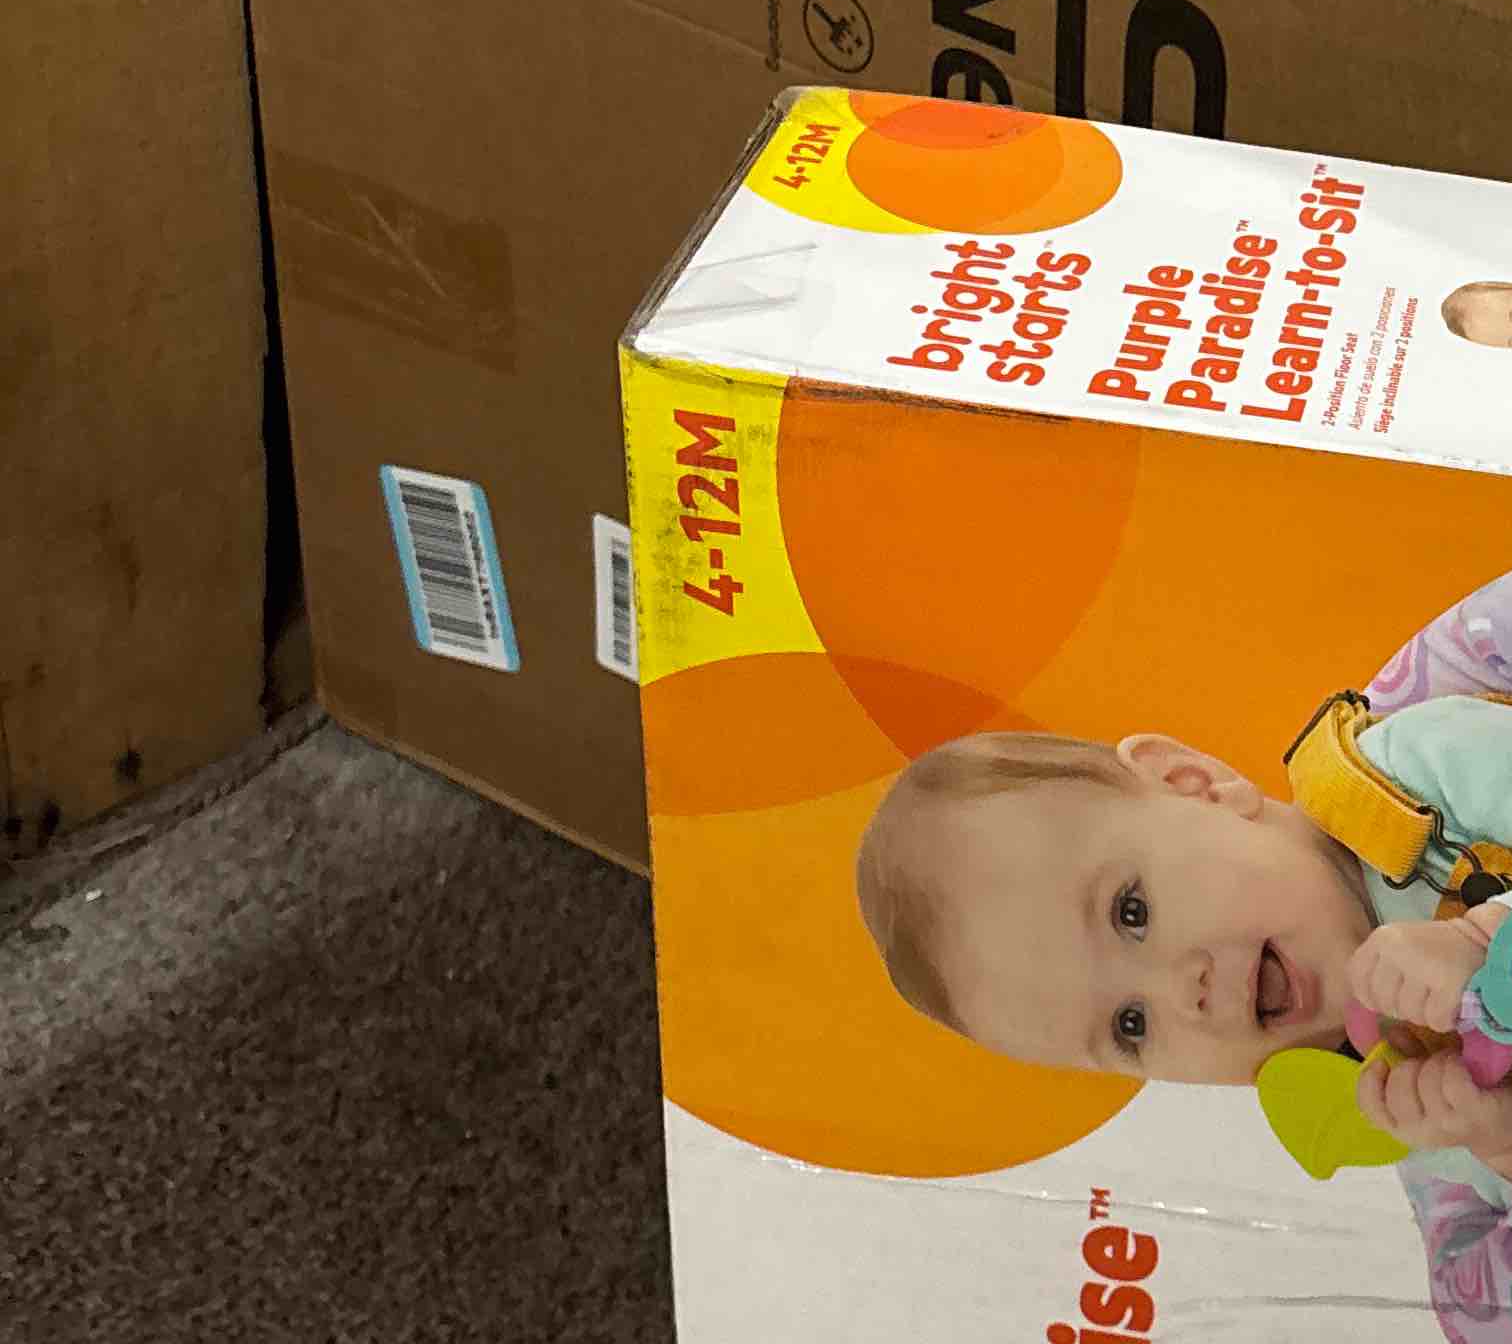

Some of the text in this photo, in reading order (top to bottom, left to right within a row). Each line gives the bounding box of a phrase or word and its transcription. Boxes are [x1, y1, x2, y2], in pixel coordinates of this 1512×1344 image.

[772, 123, 842, 190] 4-12M
[887, 239, 1017, 373] bright
[1087, 265, 1195, 402] Purple
[1321, 332, 1358, 427] 2-Position Floor Seat
[672, 408, 743, 617] 4-12M
